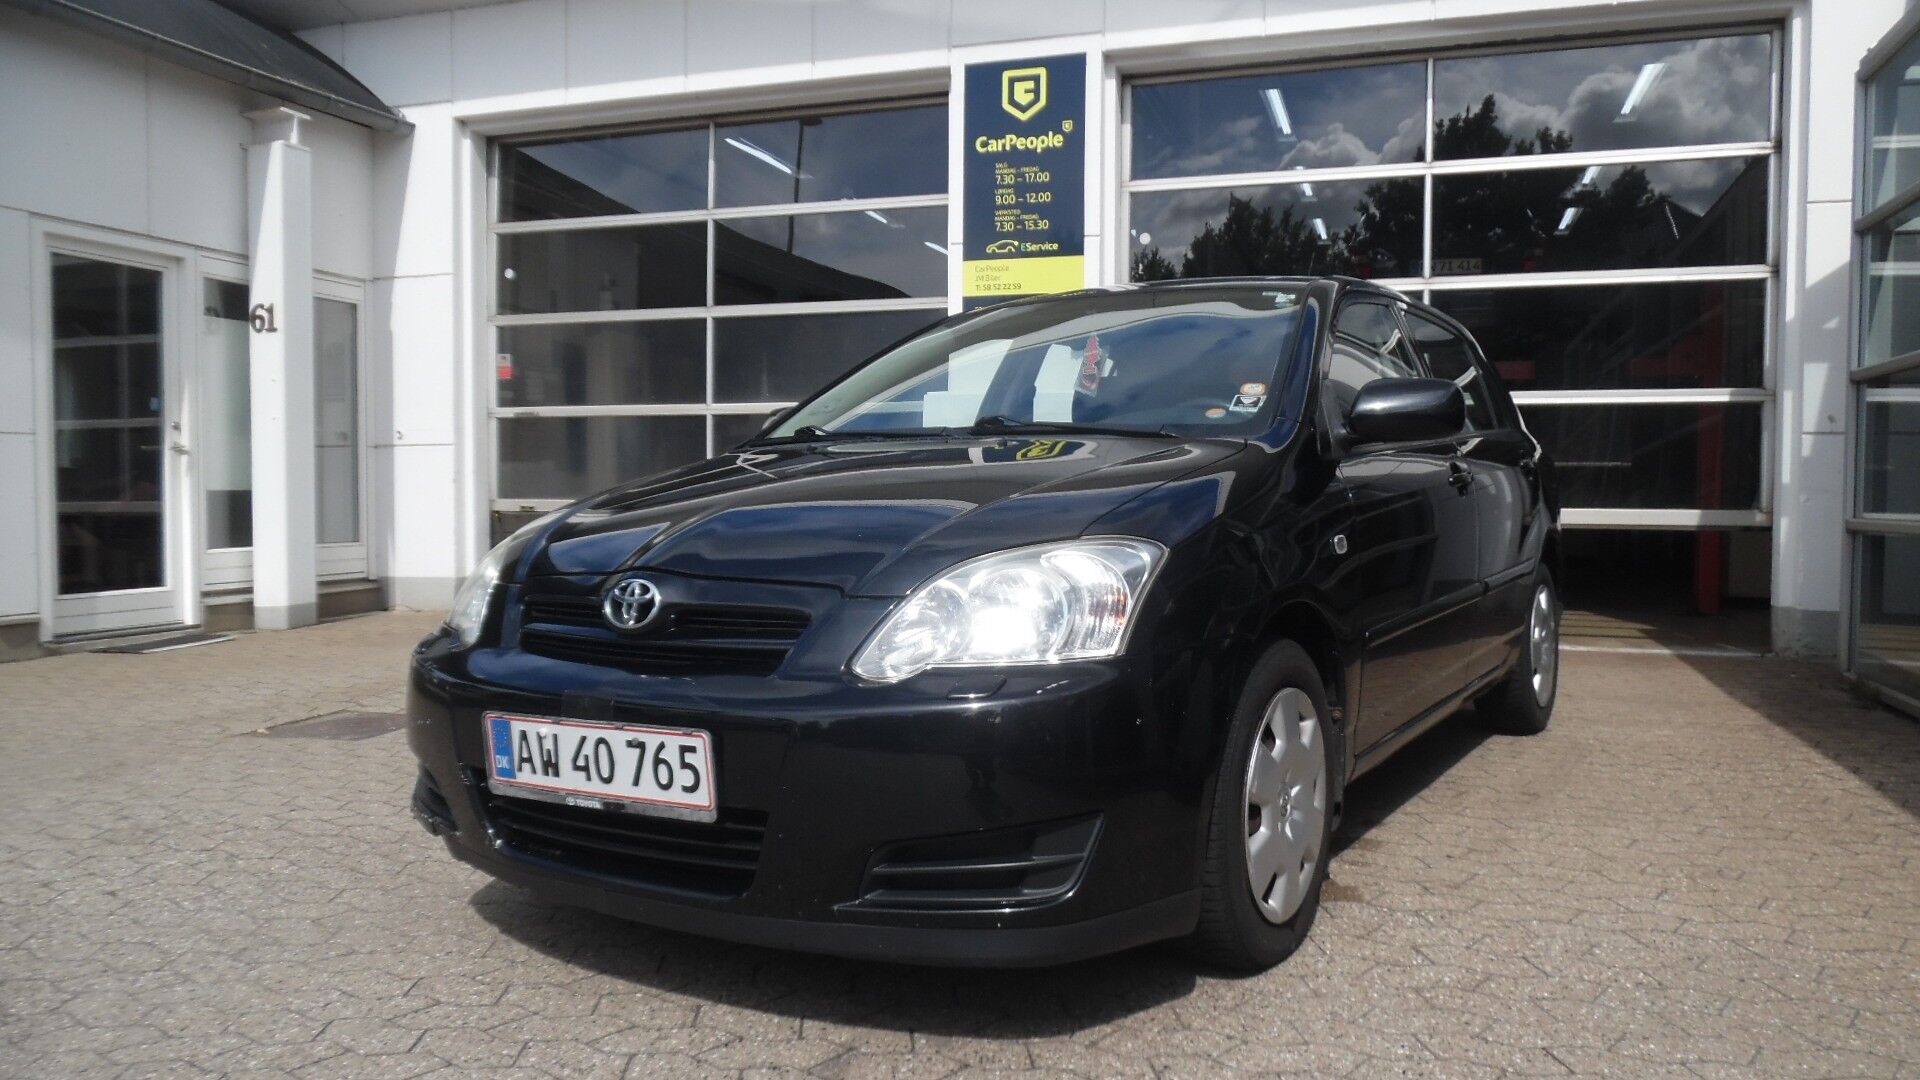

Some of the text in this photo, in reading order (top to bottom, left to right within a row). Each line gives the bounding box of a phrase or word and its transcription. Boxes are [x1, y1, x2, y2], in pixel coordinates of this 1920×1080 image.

[975, 131, 1064, 154] CarPeople
[996, 174, 1015, 184] 7.30
[1025, 172, 1050, 183] 17.00
[995, 194, 1016, 205] 9.00
[1025, 192, 1051, 203] 12.00
[995, 221, 1014, 232] 7.30
[1024, 219, 1049, 231] 15.30
[975, 264, 1009, 273] CarPeople
[1012, 282, 1022, 290] 59
[249, 303, 278, 334] 61
[496, 755, 511, 770] DK
[516, 729, 701, 794] AW 40 765
[576, 799, 601, 809] TOYOTA
